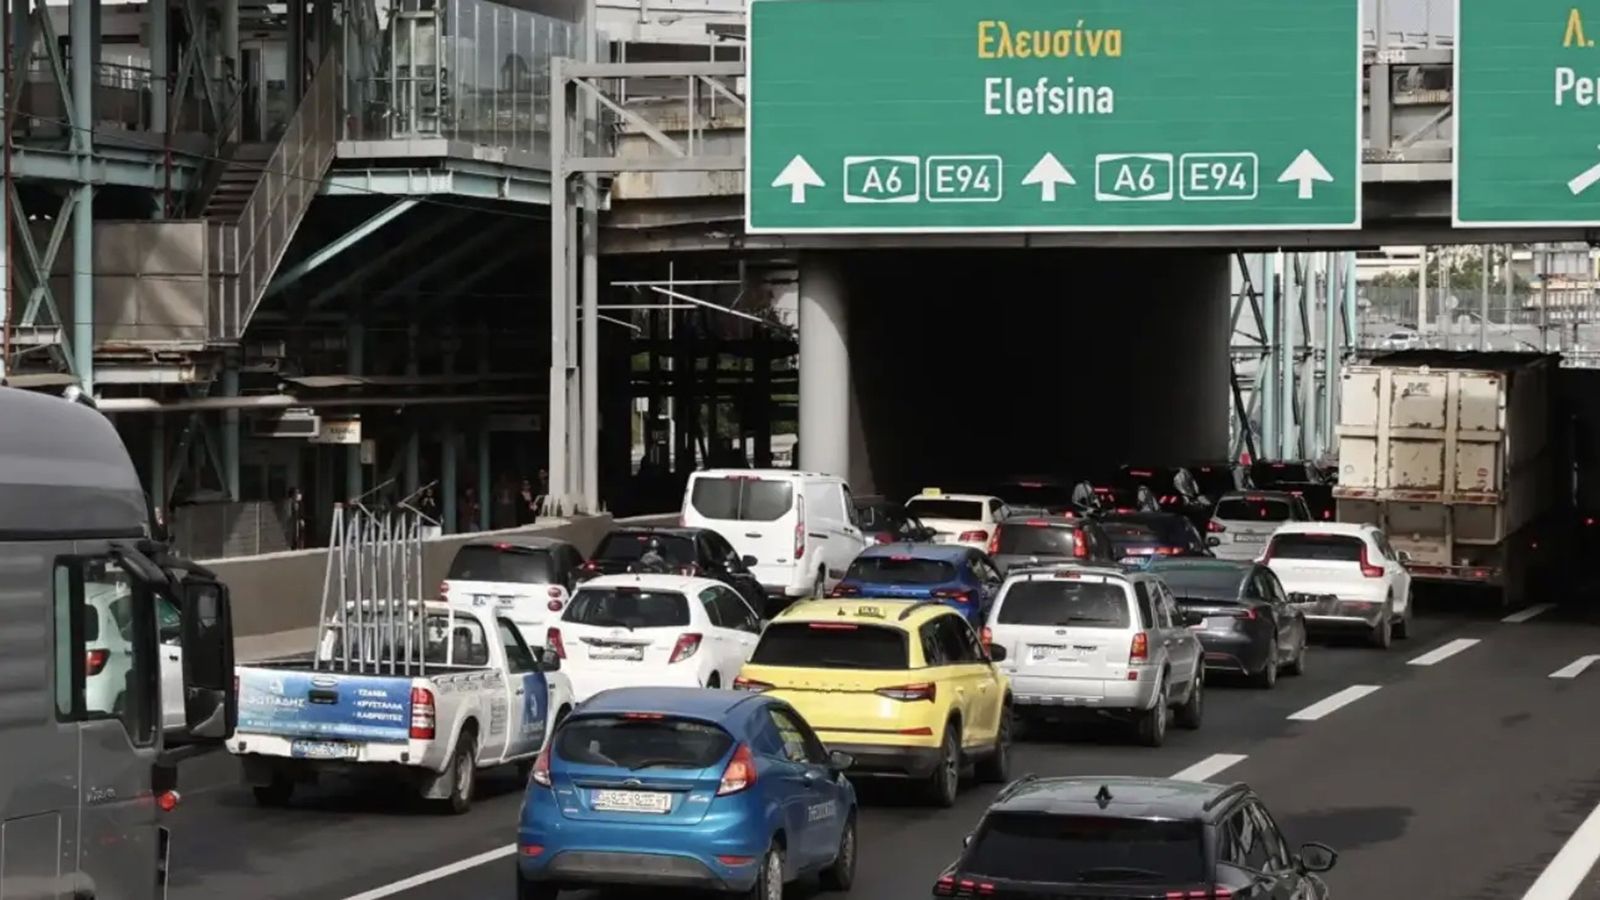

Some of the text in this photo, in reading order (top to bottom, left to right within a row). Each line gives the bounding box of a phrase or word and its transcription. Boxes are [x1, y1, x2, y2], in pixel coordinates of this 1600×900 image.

[977, 19, 1122, 59] Ελευσίνα
[1564, 9, 1595, 47] Λ.
[984, 77, 1114, 116] Elefsina
[862, 165, 902, 193] A6
[936, 165, 991, 193] E94
[1115, 164, 1155, 192] A6
[1190, 162, 1247, 191] E94
